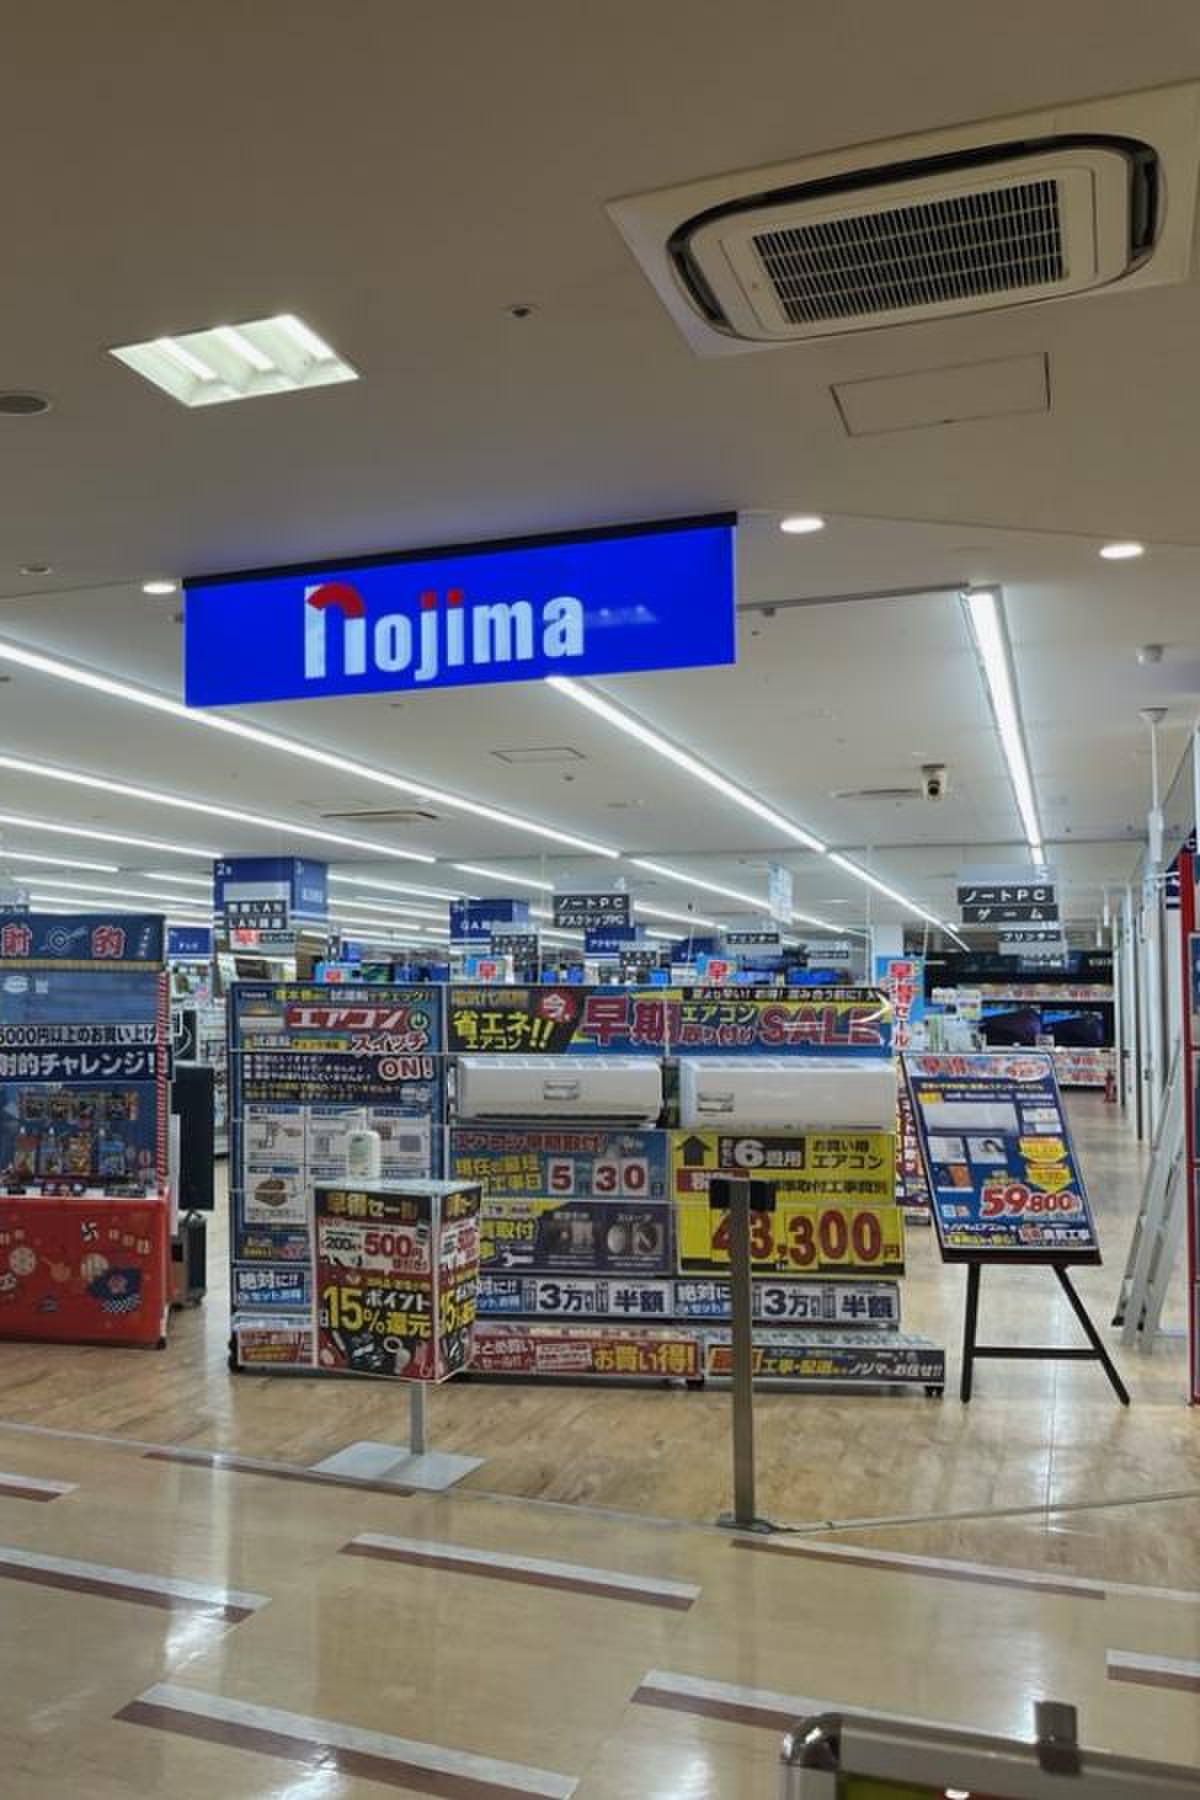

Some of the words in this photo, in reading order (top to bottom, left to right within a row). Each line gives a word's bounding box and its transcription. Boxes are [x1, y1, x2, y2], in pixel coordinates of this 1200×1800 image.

[304, 583, 584, 681] nojima
[560, 897, 624, 908] ノートPC
[963, 888, 1046, 902] ノートPC
[977, 908, 1043, 920] ゲーム
[290, 1007, 403, 1029] エアコン
[682, 1004, 756, 1022] エアコン
[759, 1005, 880, 1045] SALE
[465, 1036, 522, 1049] エアコン
[813, 1154, 883, 1170] エアコン
[367, 1288, 432, 1312] ポイント
[614, 1289, 664, 1312] 半額
[842, 1294, 894, 1319] 半額
[594, 1343, 694, 1374] お買い得!
